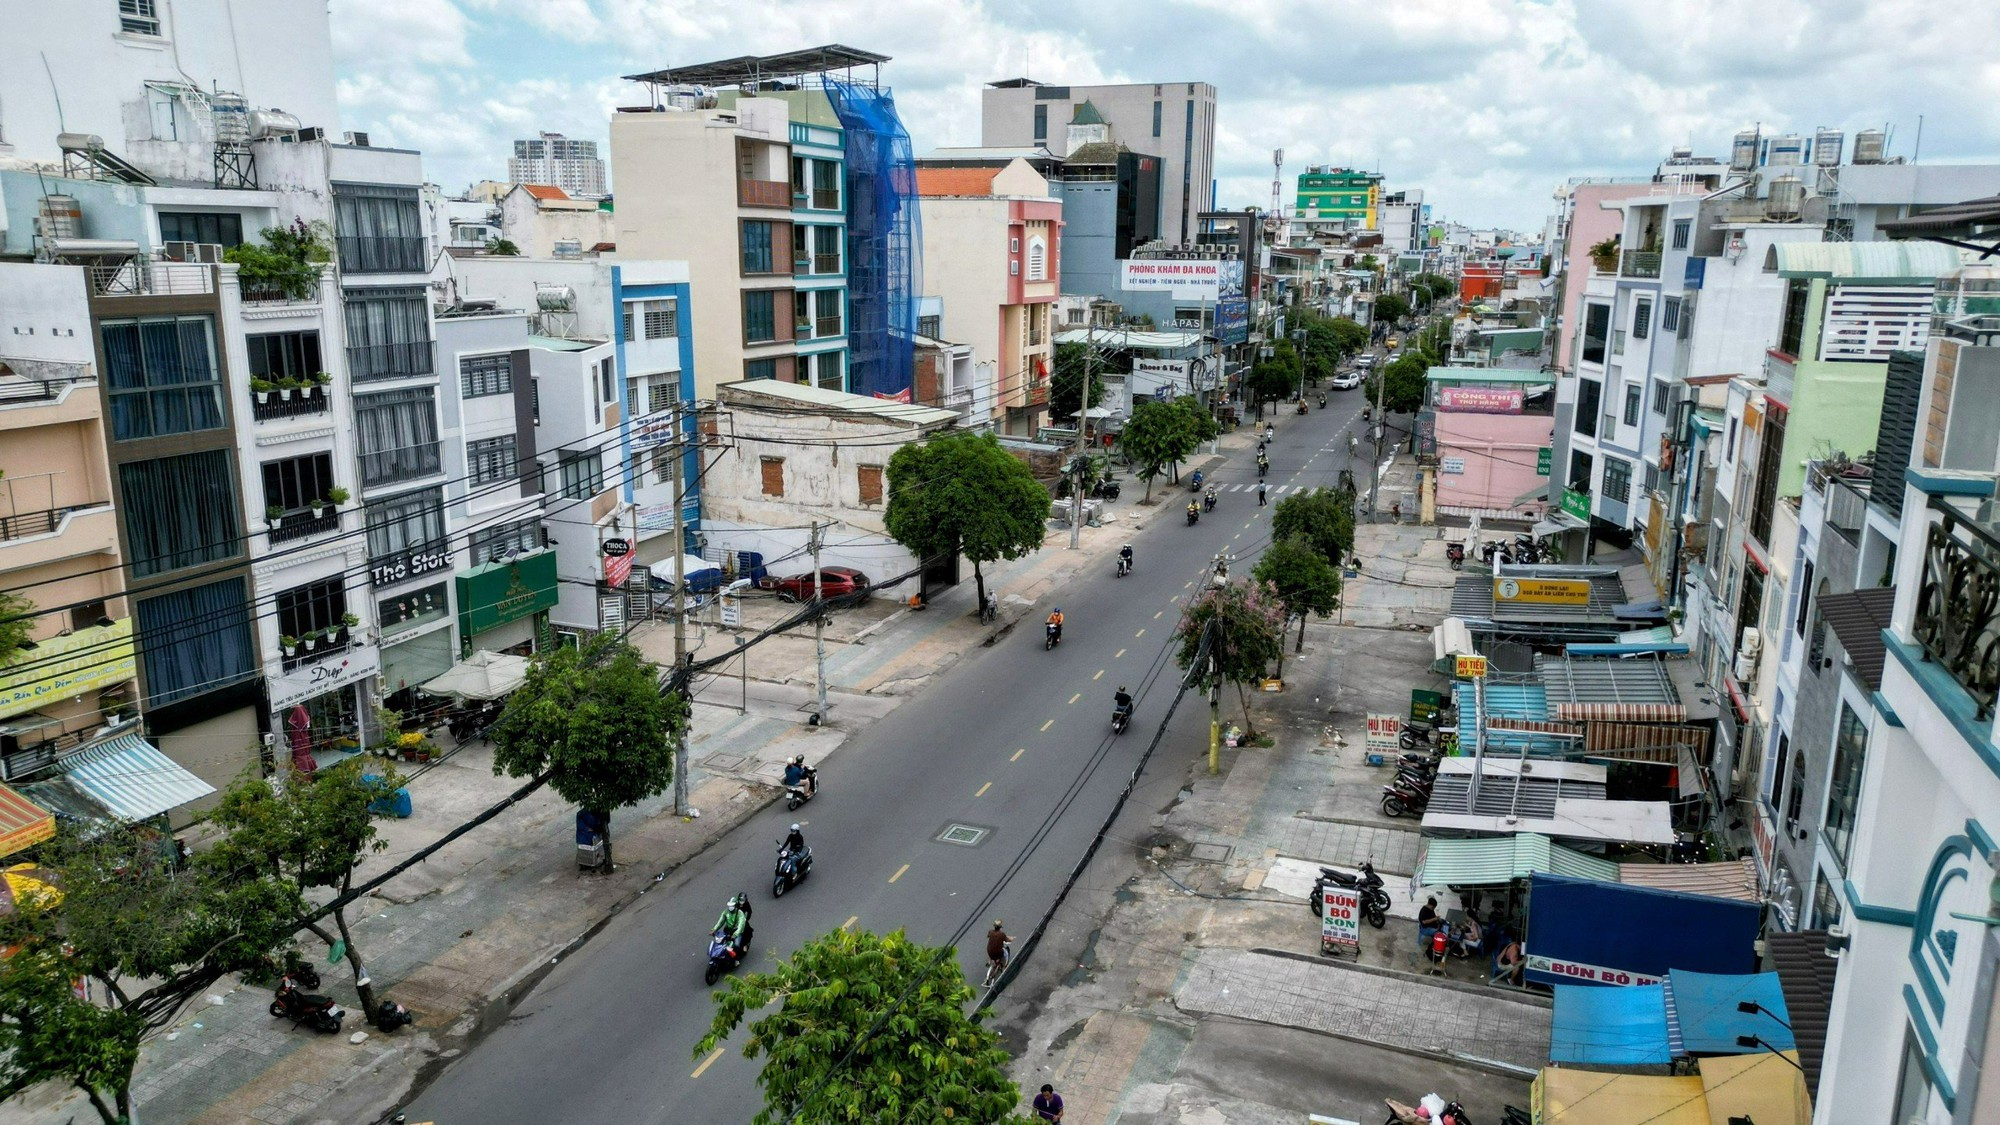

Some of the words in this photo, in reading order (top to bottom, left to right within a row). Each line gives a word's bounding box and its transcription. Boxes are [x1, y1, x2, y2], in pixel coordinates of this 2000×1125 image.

[1129, 262, 1155, 273] PHÒNG
[1157, 263, 1180, 274] KHÁM
[1182, 265, 1193, 274] ĐA
[1195, 265, 1216, 274] KHOA
[1162, 319, 1201, 328] HAPAS
[1453, 392, 1487, 400] CÔNG
[606, 542, 628, 550] THOCA
[412, 550, 455, 574] Store
[1458, 658, 1468, 669] HỦ
[1469, 657, 1485, 670] TIẾU
[1368, 715, 1379, 732] HỦ
[1381, 716, 1399, 733] TIẾU
[1325, 894, 1357, 908] BÚN
[1330, 907, 1351, 919] BÒ
[1325, 917, 1356, 928] SON
[1551, 963, 1595, 979] BÚN
[1601, 972, 1631, 985] BÒ
